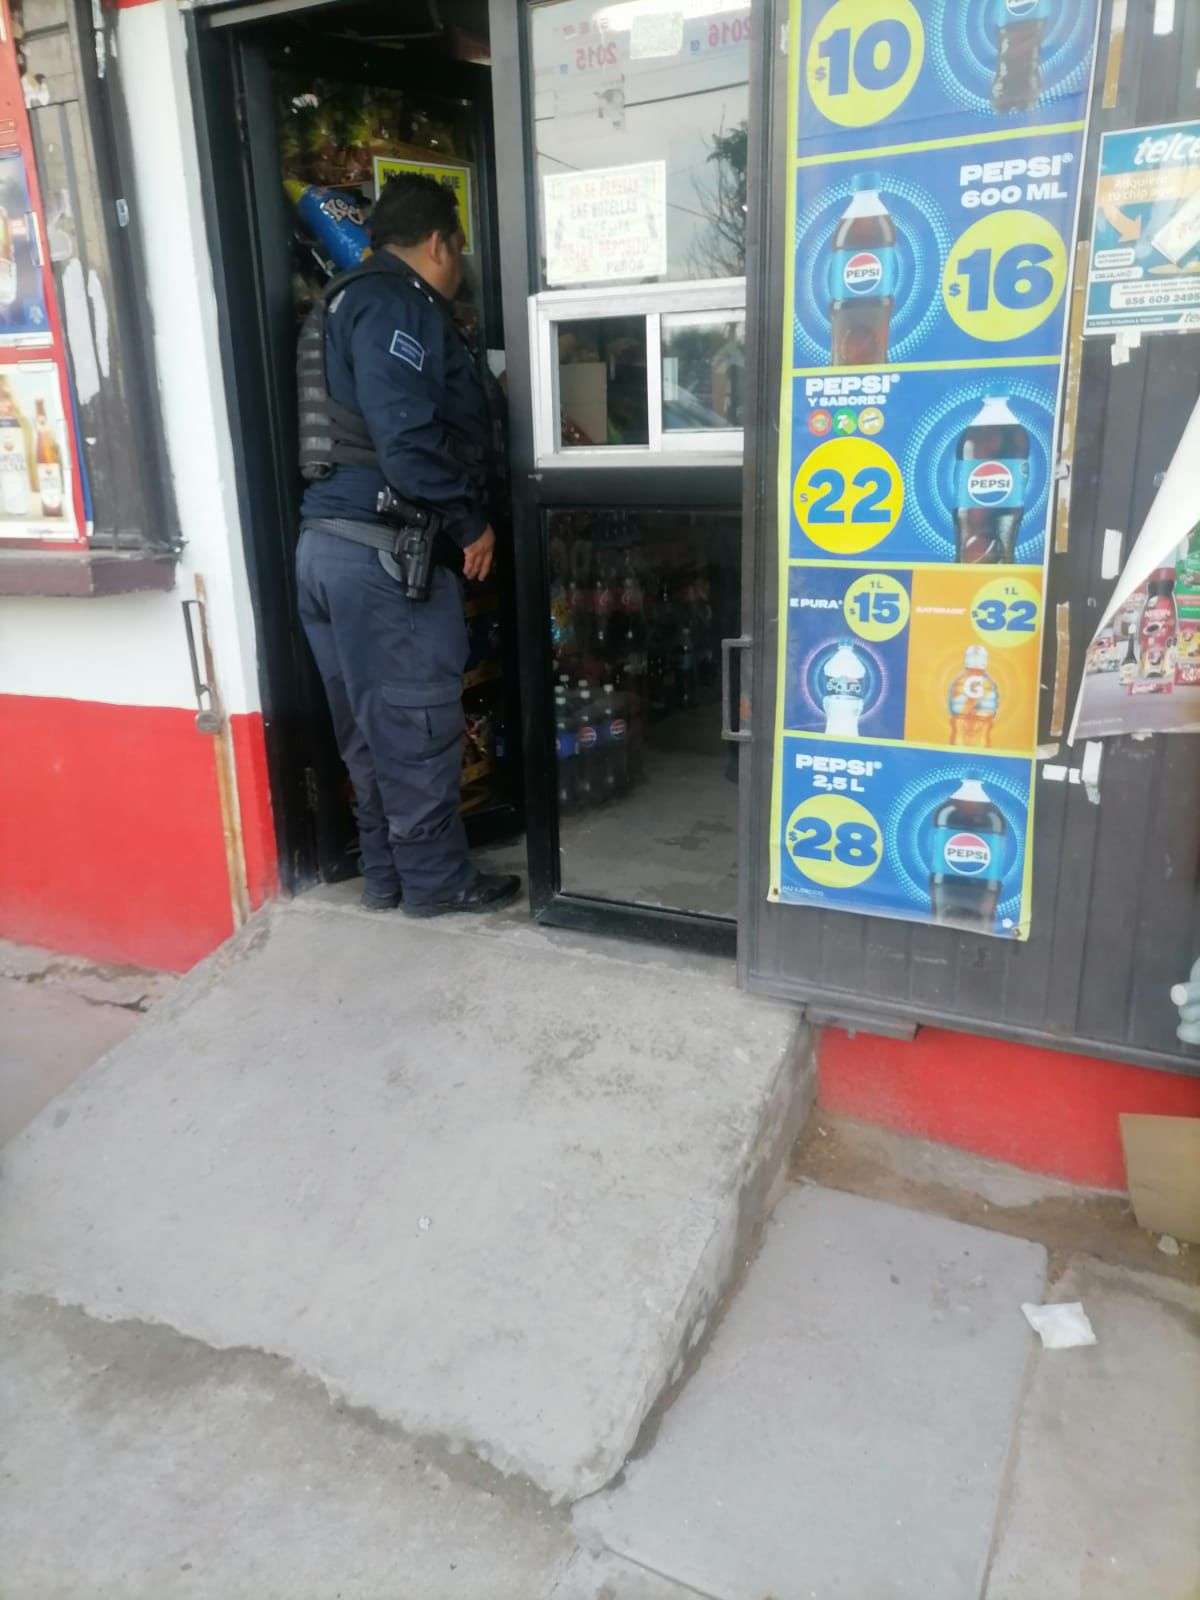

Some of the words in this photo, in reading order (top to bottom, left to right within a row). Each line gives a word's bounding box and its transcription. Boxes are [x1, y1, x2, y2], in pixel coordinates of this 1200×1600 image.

[814, 18, 912, 97] $10
[960, 185, 1023, 209] 600
[1026, 182, 1068, 201] ML
[845, 268, 881, 279] PEPSI
[949, 242, 1055, 313] $16
[807, 397, 818, 408] Y
[819, 395, 887, 407] SABORES
[800, 466, 893, 524] $22
[969, 478, 1011, 489] PEPSI
[849, 591, 901, 625] $15
[972, 599, 1038, 632] $32
[964, 675, 985, 699] G
[812, 774, 848, 791] 2,5
[850, 778, 865, 793] L
[788, 816, 878, 867] $28
[946, 846, 989, 862] PEPSI
